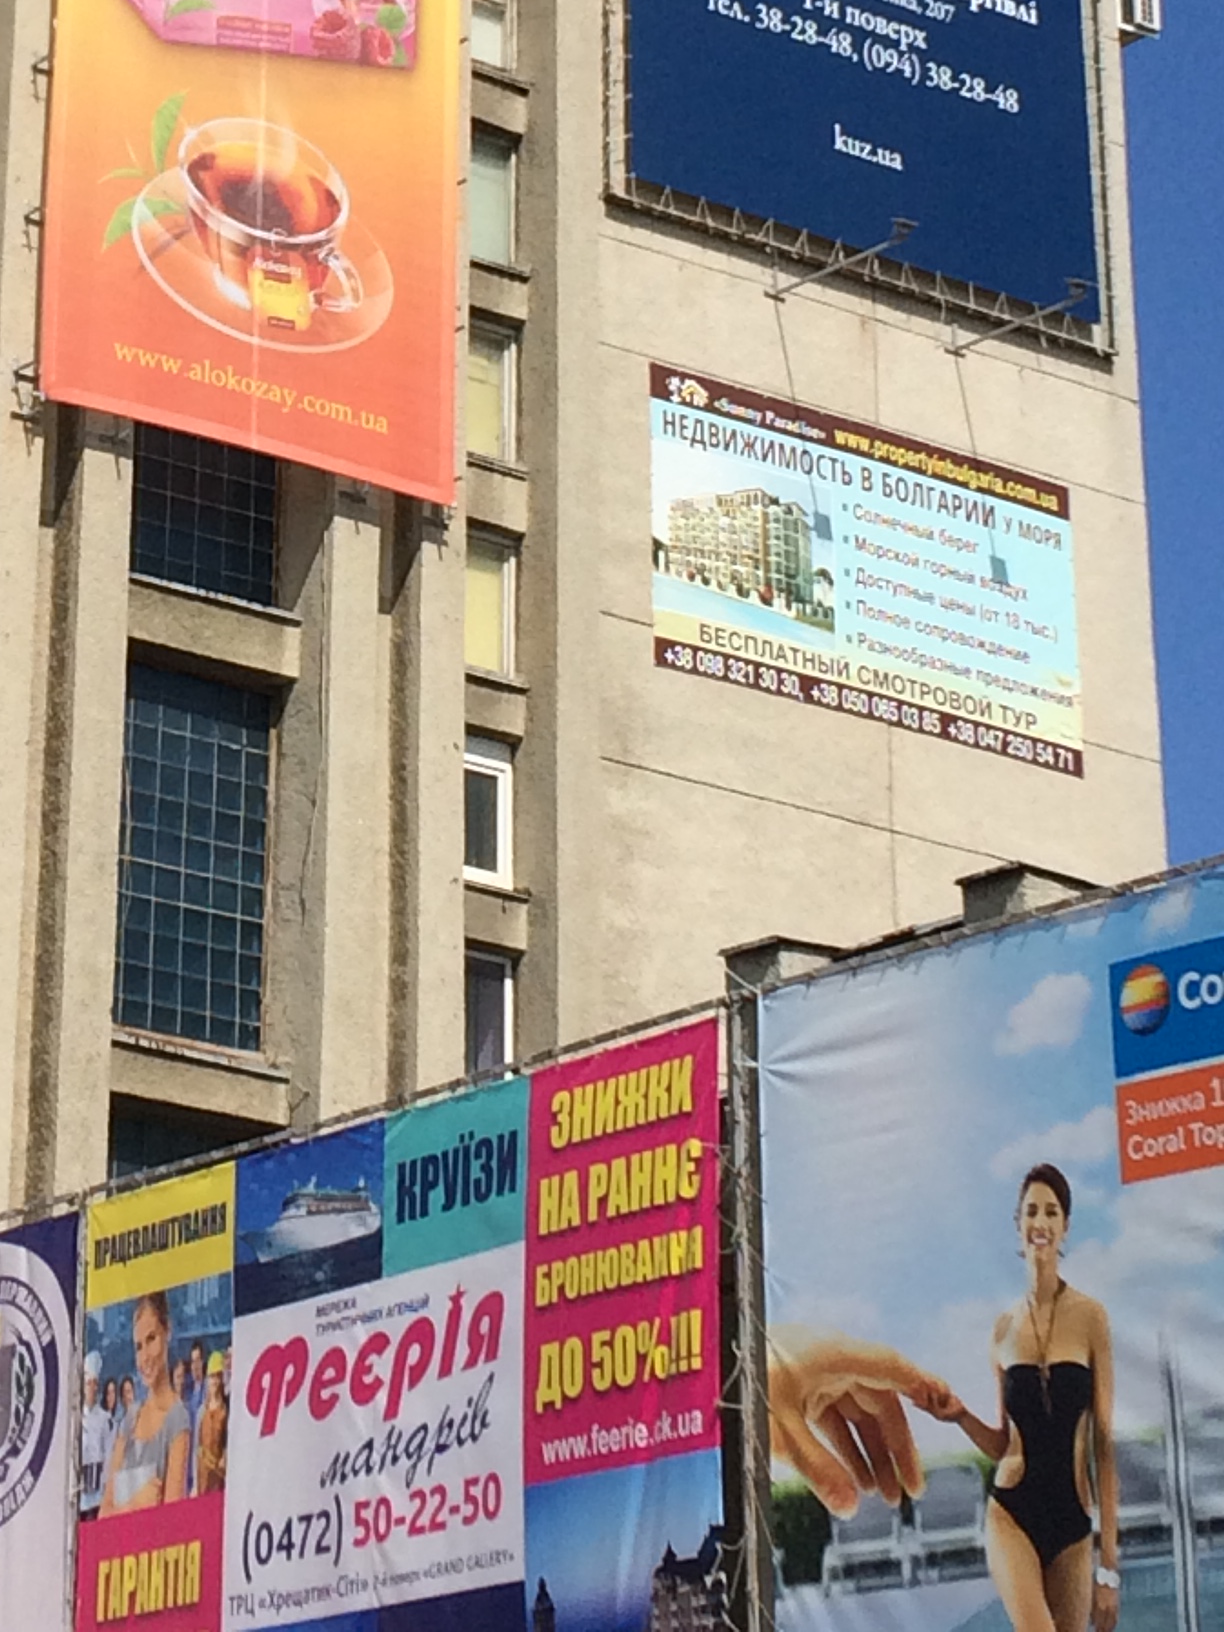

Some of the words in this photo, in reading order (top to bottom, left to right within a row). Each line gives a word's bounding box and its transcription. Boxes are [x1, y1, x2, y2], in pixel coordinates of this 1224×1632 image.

[755, 4, 858, 62] 38-28-48,
[863, 38, 920, 85] (094)
[925, 62, 1019, 113] 38-28-48
[845, 5, 927, 50] поверх
[834, 123, 903, 171] kuz.ua
[113, 340, 389, 435] www.alokozay.com.ua
[662, 409, 853, 486] НЕДВИЖИМОСТЬ
[860, 466, 874, 493] В
[881, 471, 996, 530] БОЛГАРИИ
[1018, 519, 1062, 551] МОРЯ
[856, 599, 911, 630] Полное
[664, 646, 693, 668] +38
[727, 659, 754, 685] 321
[758, 667, 778, 692] 30
[699, 622, 851, 681] БЕСПЛАТНЫЙ
[857, 664, 994, 720] СМОТРОВОЙ
[998, 704, 1038, 732] ТУР
[551, 1055, 693, 1152] ЗНИЖКИ
[1126, 1092, 1205, 1125] Знижка
[1127, 1126, 1186, 1161] Coral
[396, 1130, 518, 1226] КРУЇЗИ
[538, 1166, 582, 1237] НА
[587, 1138, 702, 1226] РАННЄ
[93, 1201, 227, 1272] ПРАЦЕВЛАШТУВАННЯ
[534, 1226, 702, 1309] БРОНЮВАННЯ
[535, 1335, 584, 1413] ДО
[591, 1309, 702, 1396] 50%!!!
[320, 1371, 495, 1489] мандрів
[542, 1409, 703, 1465] www.feerie.ck.ua
[242, 1494, 343, 1584] (0472)
[353, 1472, 502, 1549] 50-22-50
[95, 1540, 202, 1626] ГАРАНТІЯ
[229, 1596, 255, 1617] ТРЦ
